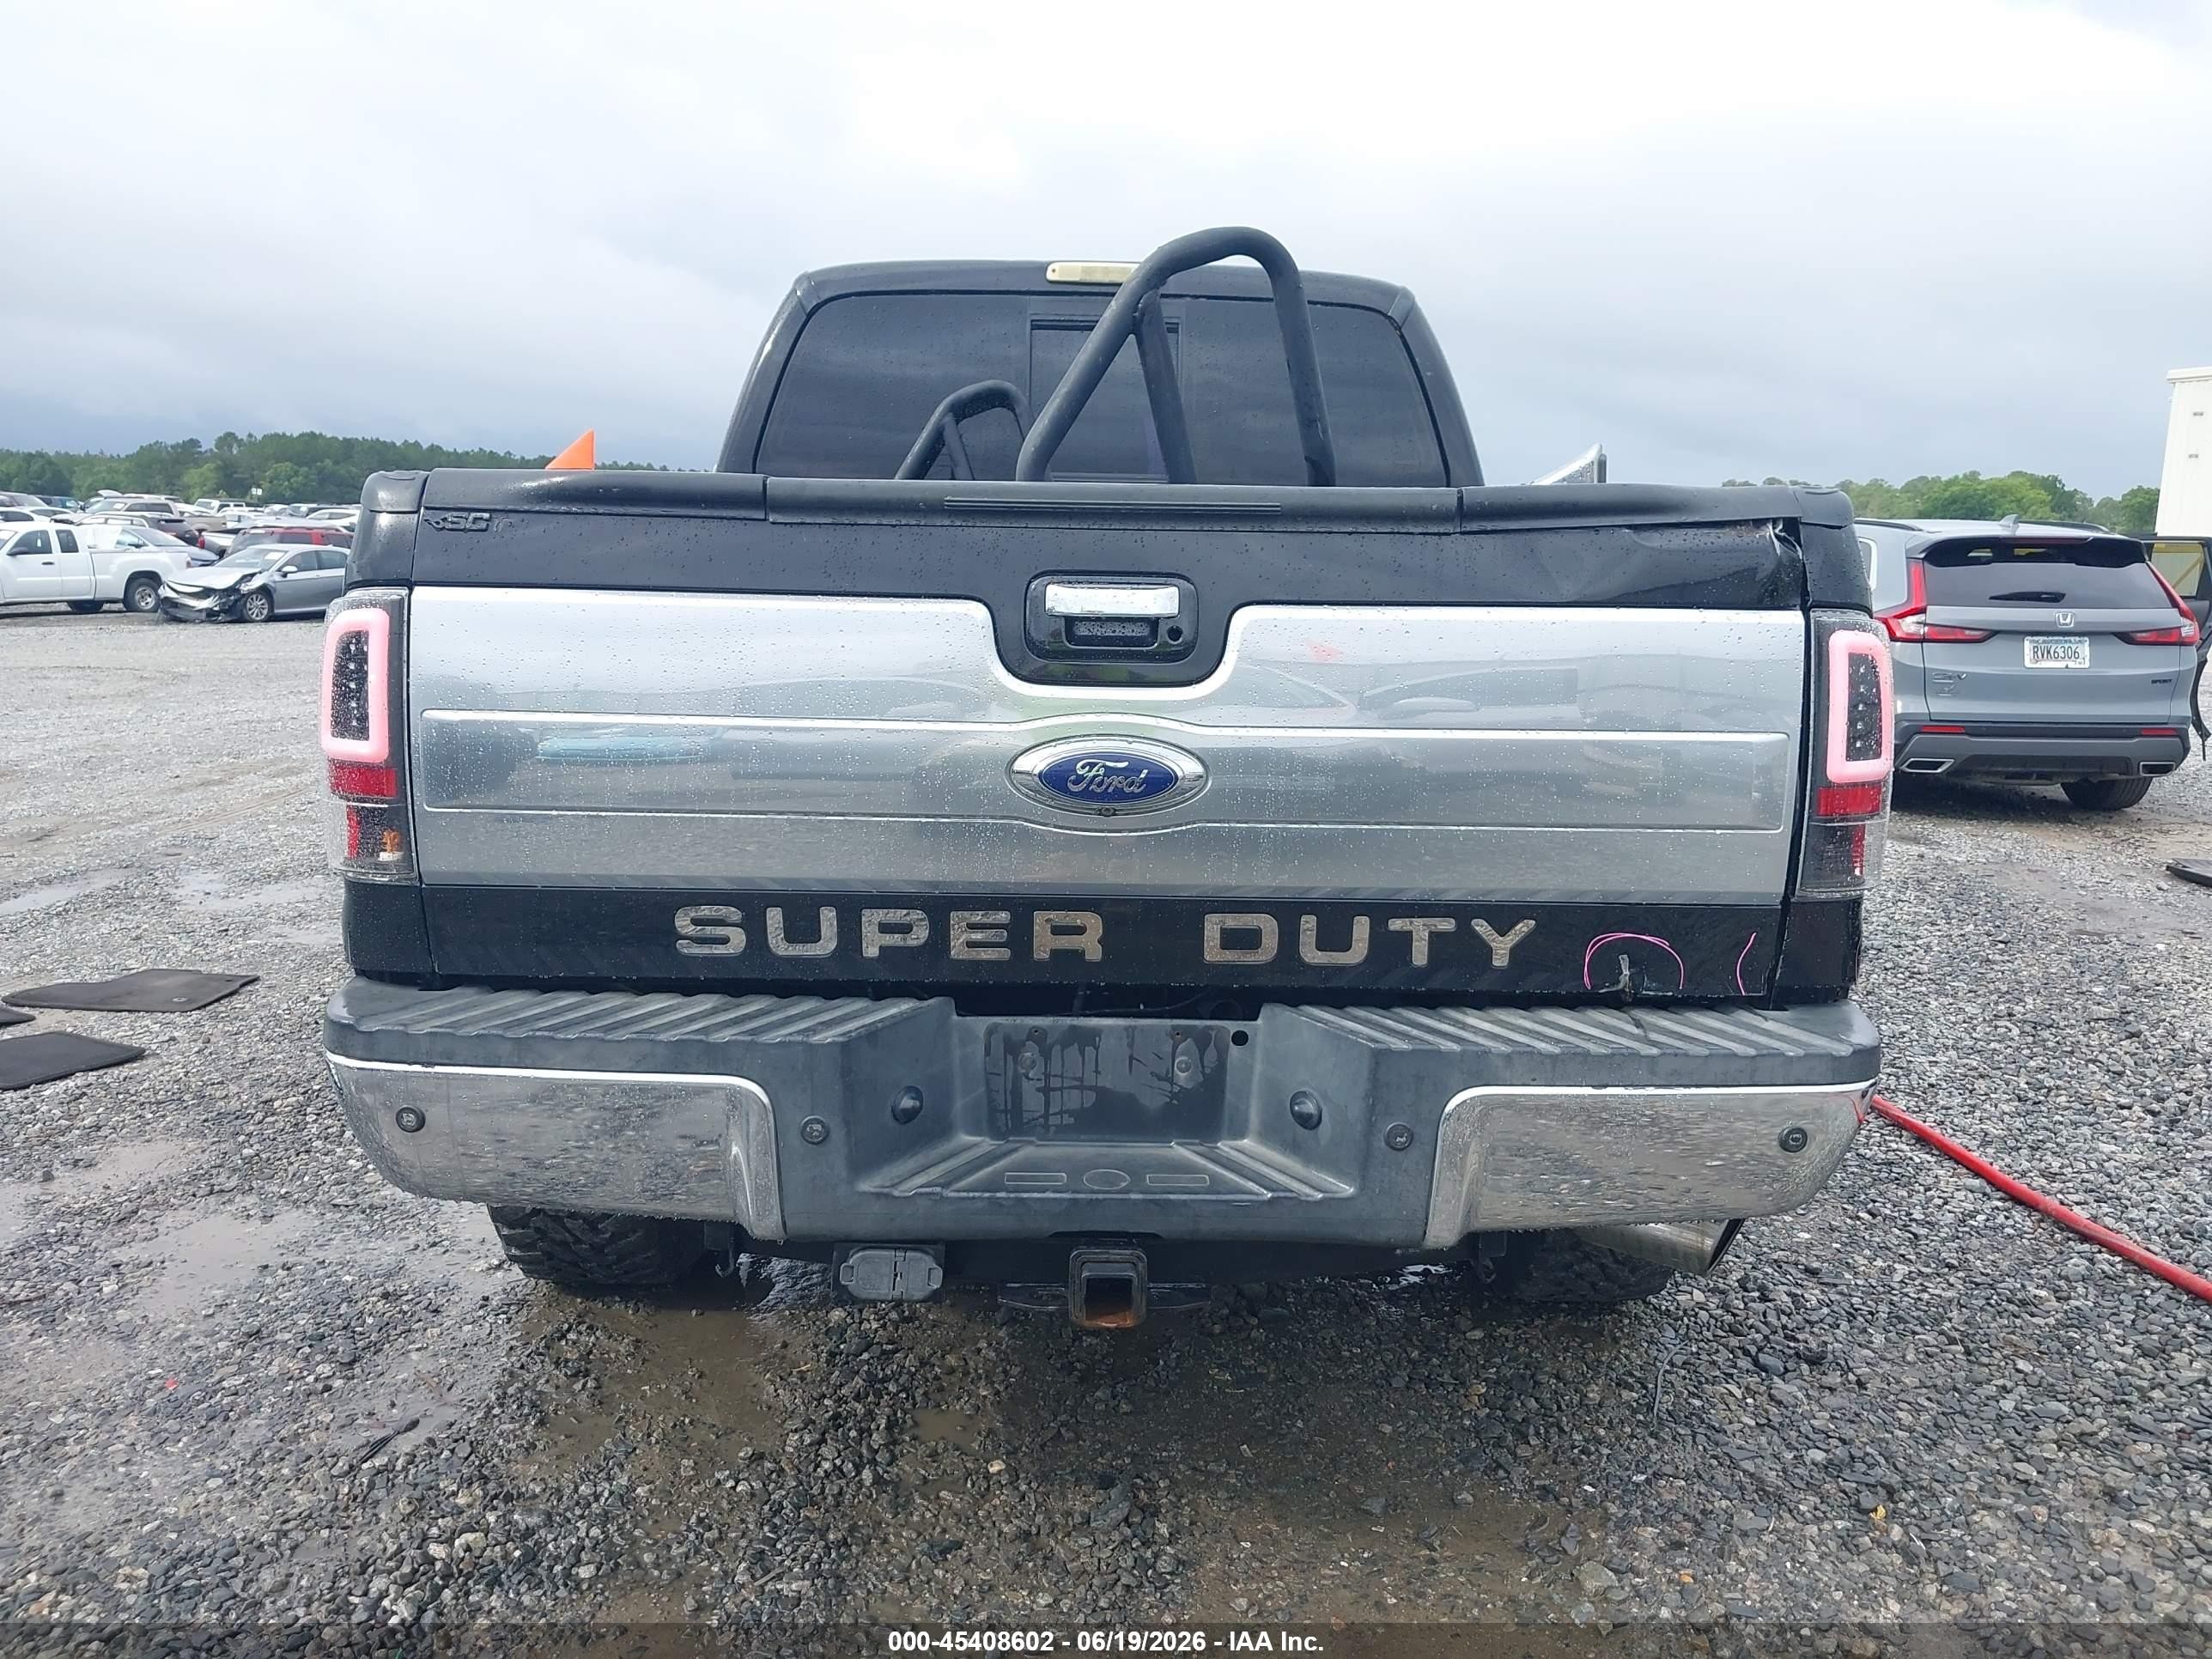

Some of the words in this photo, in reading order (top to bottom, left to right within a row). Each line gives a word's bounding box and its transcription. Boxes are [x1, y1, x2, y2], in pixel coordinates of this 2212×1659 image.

[2033, 645, 2080, 659] RVK6306
[1067, 758, 1150, 793] Ford
[674, 905, 1103, 963] SUPER
[1203, 912, 1538, 972] DUTY
